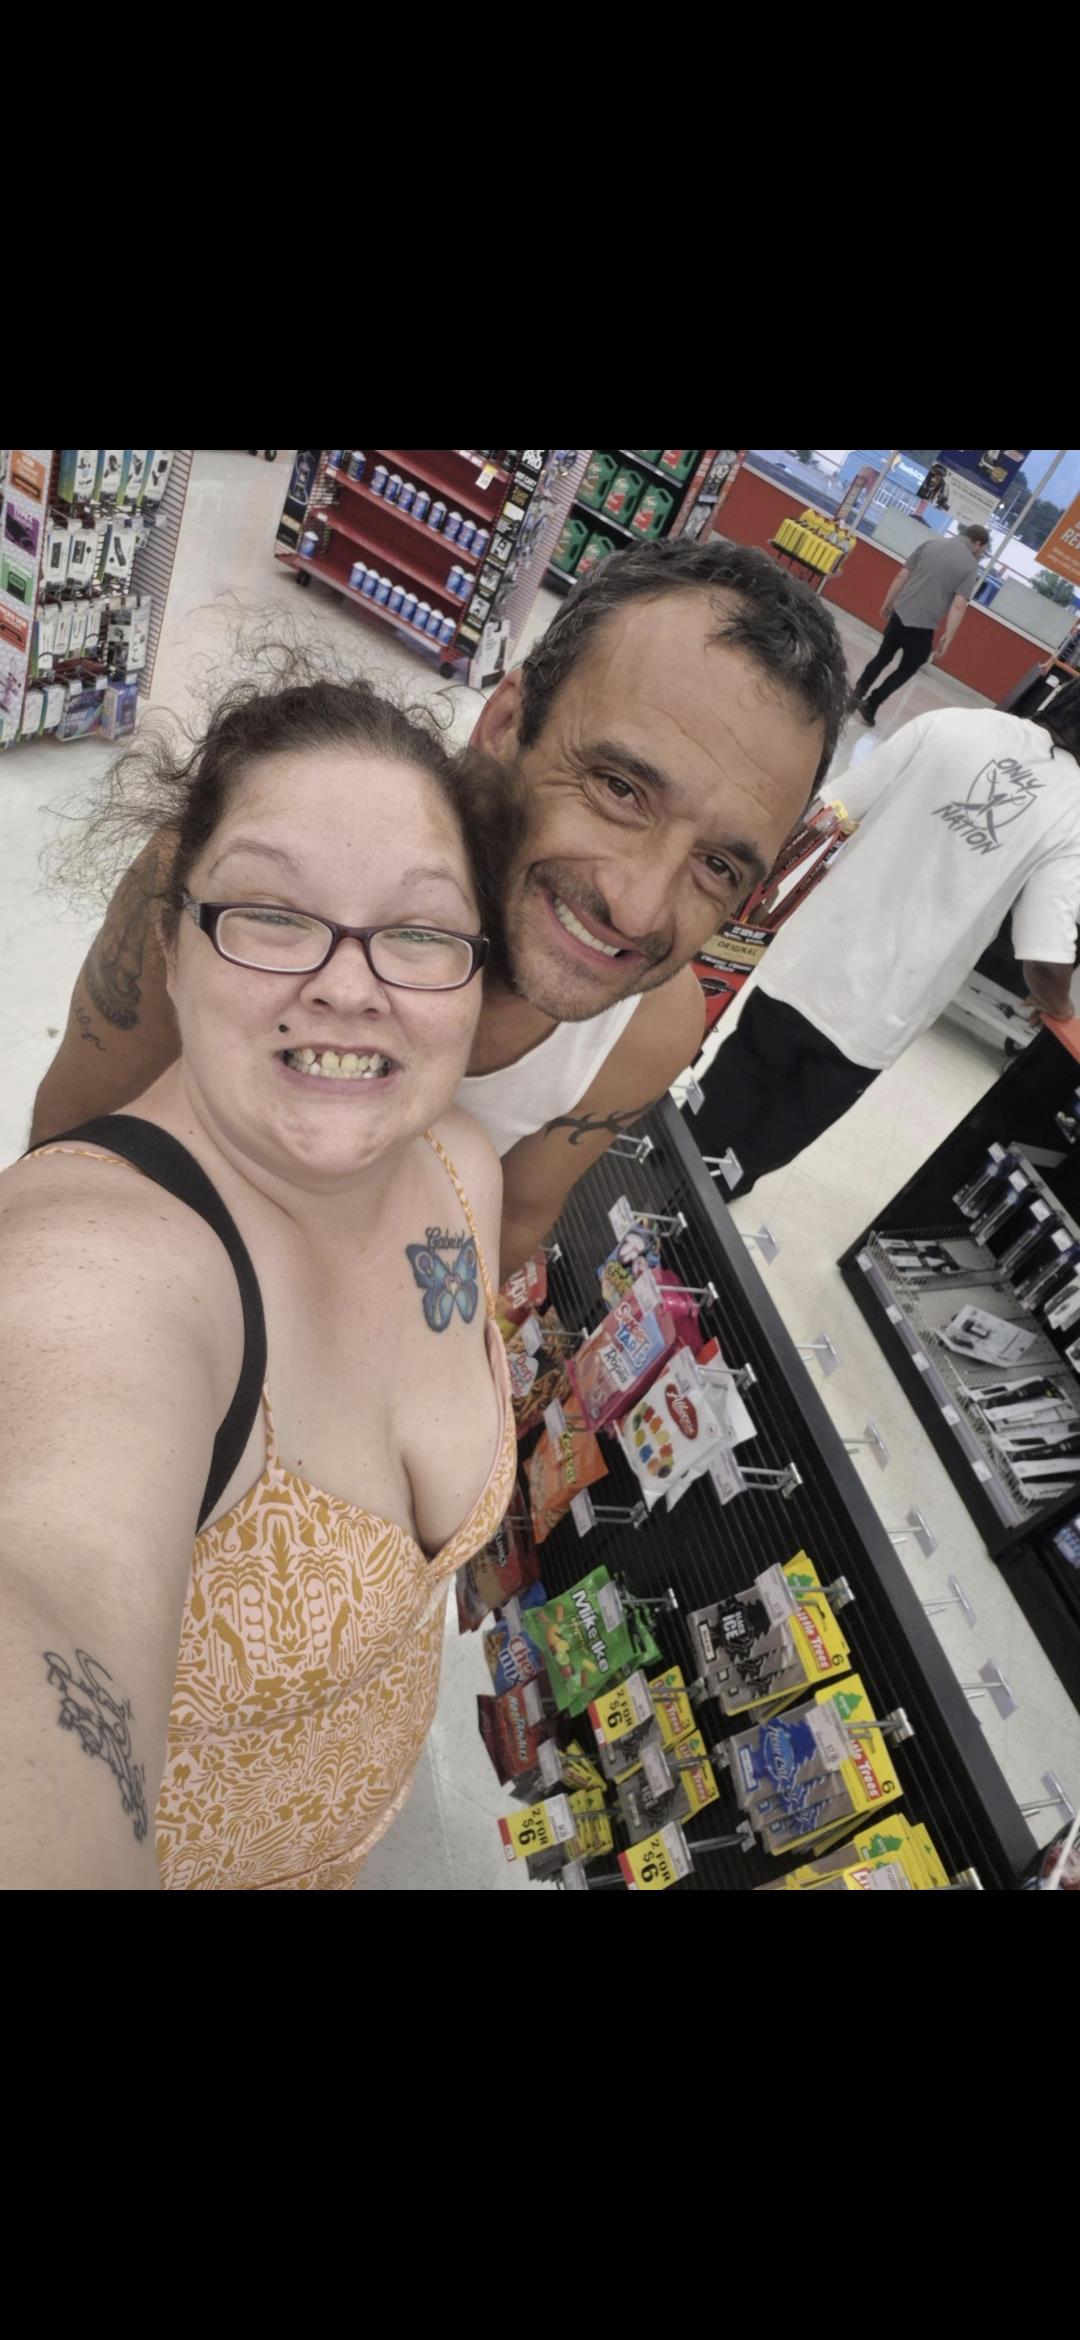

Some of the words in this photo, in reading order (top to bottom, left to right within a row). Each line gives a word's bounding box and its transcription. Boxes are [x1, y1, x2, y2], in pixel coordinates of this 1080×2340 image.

[996, 758, 1047, 793] ONLY
[931, 802, 1003, 855] NATION
[717, 940, 757, 956] ORIGINAL
[572, 1589, 598, 1639] Mike
[591, 1639, 609, 1673] Ike
[722, 1615, 739, 1641] ICE
[498, 1649, 522, 1685] mix
[811, 1638, 830, 1670] Trees
[831, 1653, 844, 1667] 6
[608, 1701, 623, 1729] $6
[617, 1690, 625, 1700] 2
[621, 1702, 633, 1727] FOR
[858, 1760, 880, 1797] Trees
[882, 1780, 895, 1795] 6
[532, 1808, 542, 1817] 2
[518, 1818, 537, 1846] $6
[535, 1820, 549, 1845] FOR
[651, 1839, 660, 1849] 2
[641, 1851, 660, 1883] $6
[655, 1852, 671, 1882] FOR
